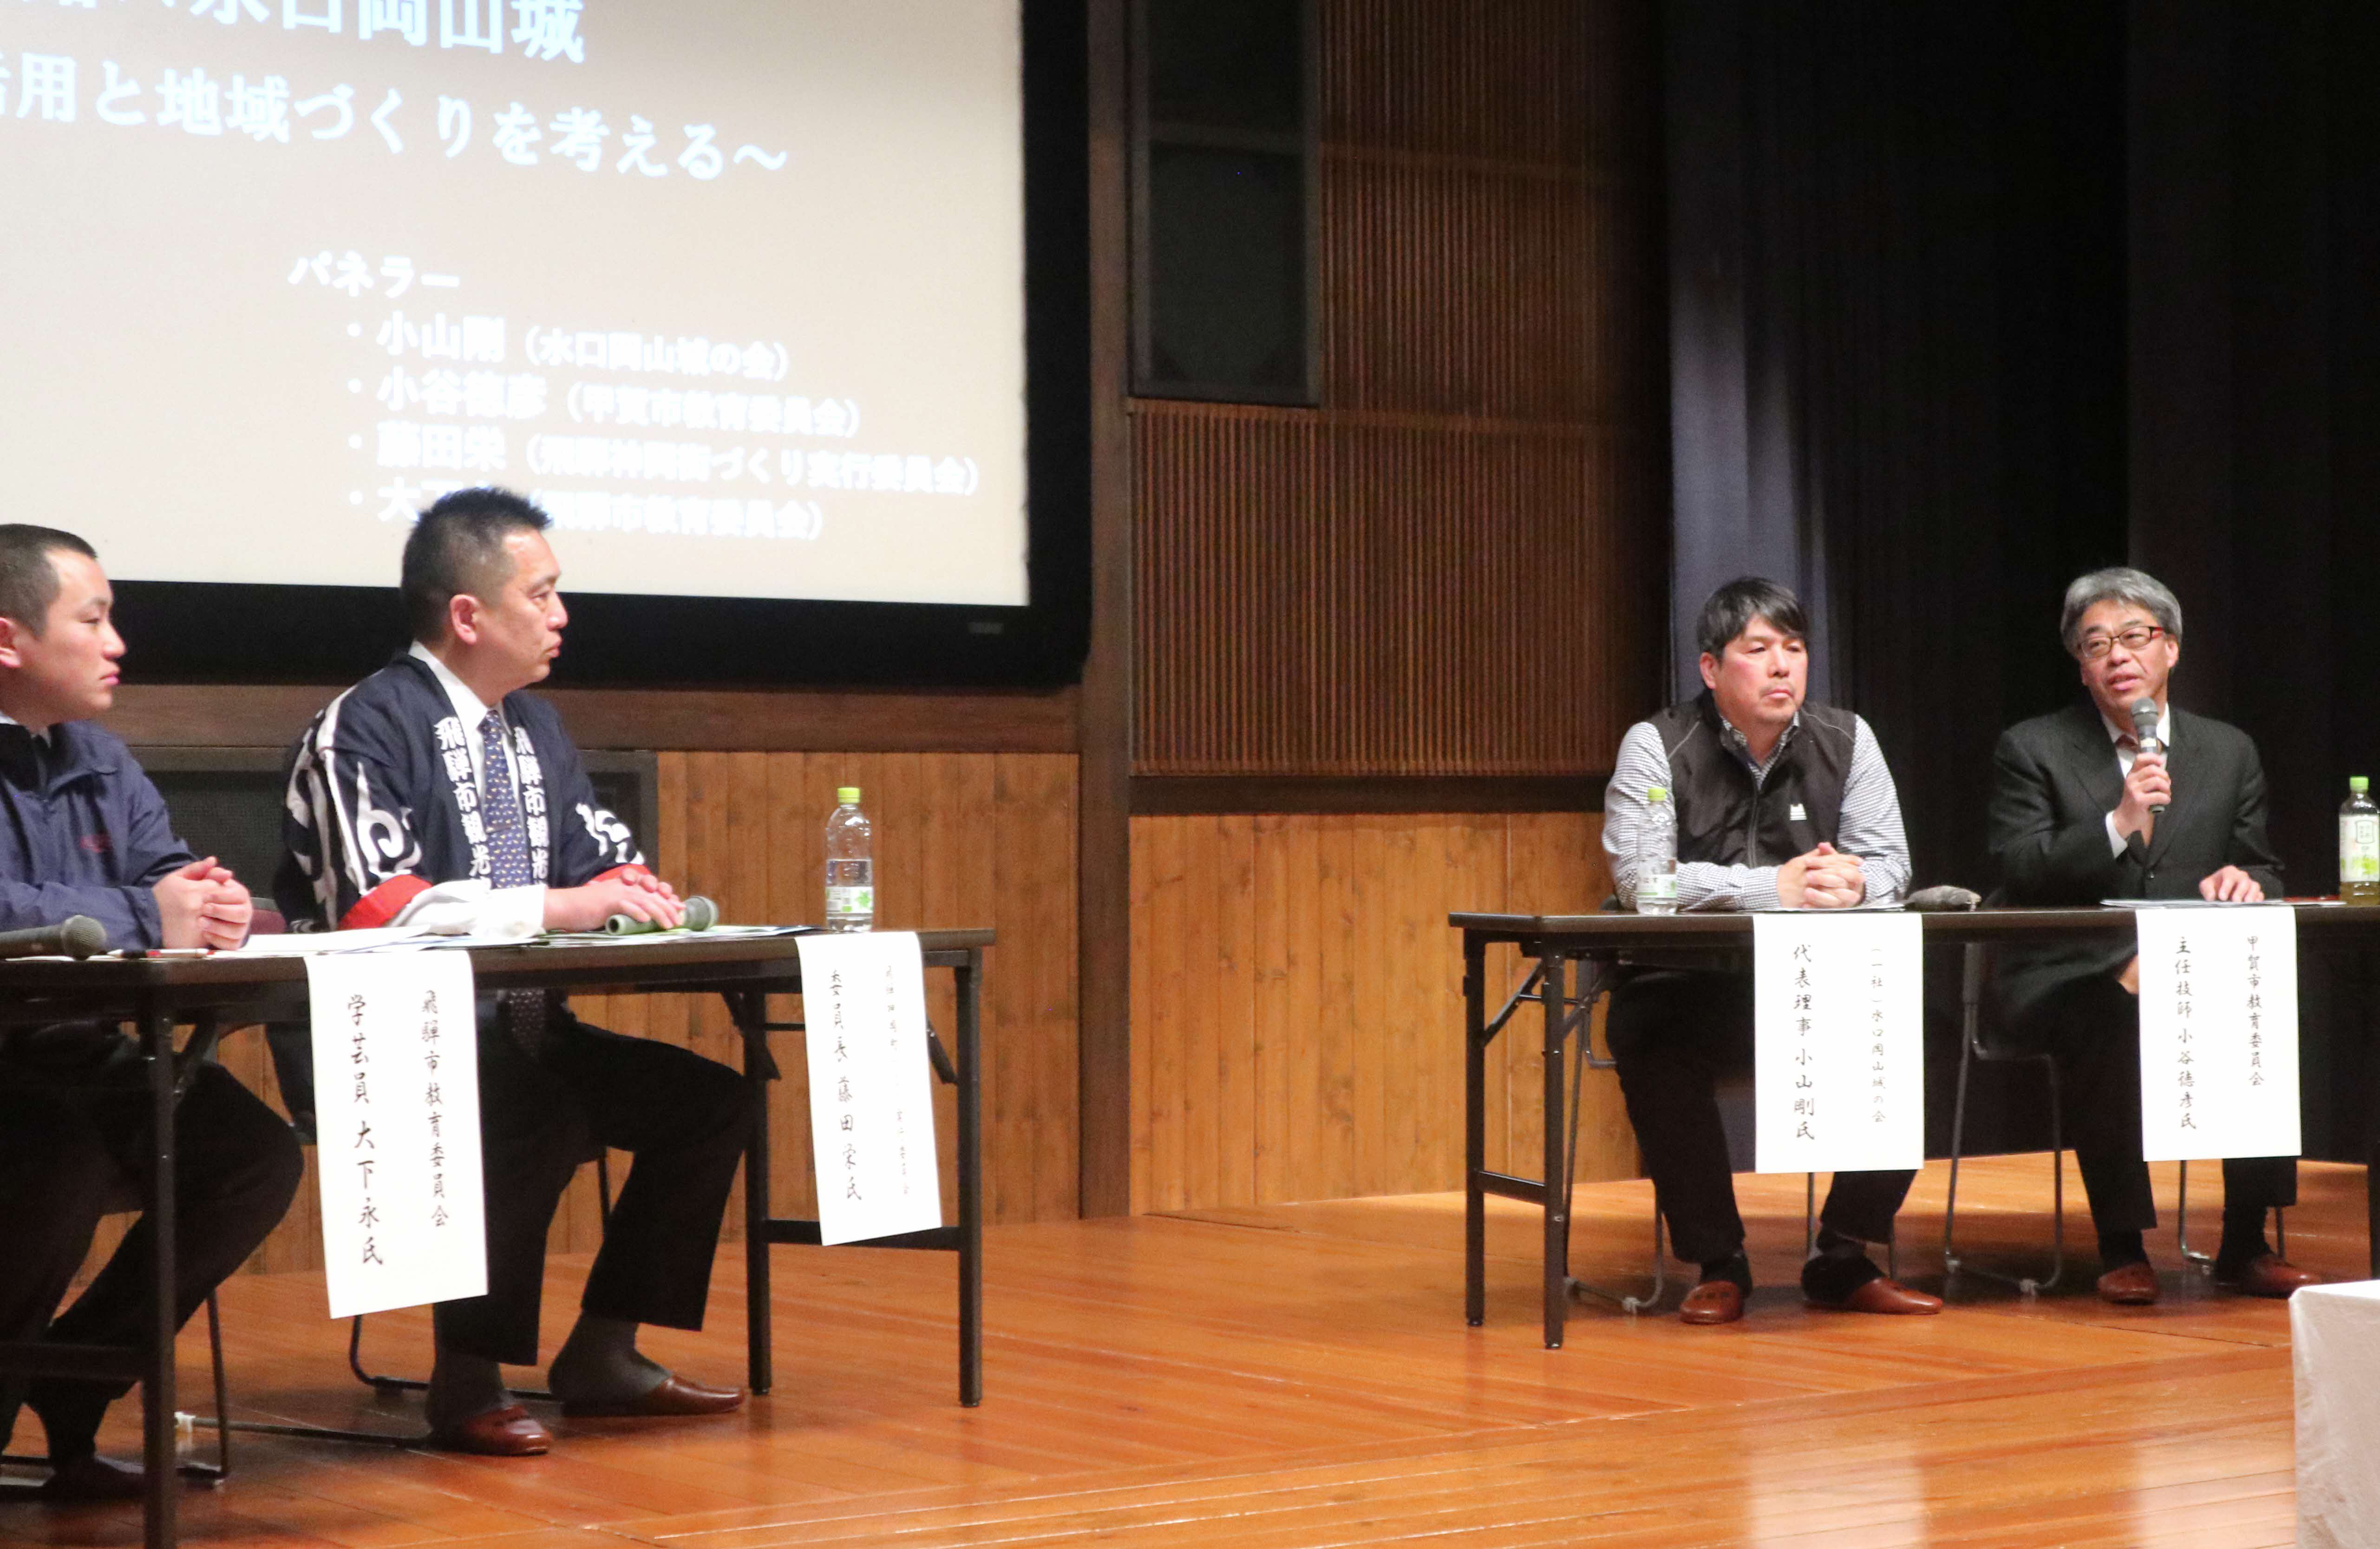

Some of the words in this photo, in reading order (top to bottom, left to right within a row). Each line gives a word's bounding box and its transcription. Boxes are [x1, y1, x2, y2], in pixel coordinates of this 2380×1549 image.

[0, 52, 788, 180] 用と地域づくりを考える～
[288, 250, 461, 298] パネラー
[433, 716, 491, 884] 飛騨市観光
[513, 726, 550, 884] 飛騨市観光
[2246, 936, 2264, 1086] 甲賀市教育委員会
